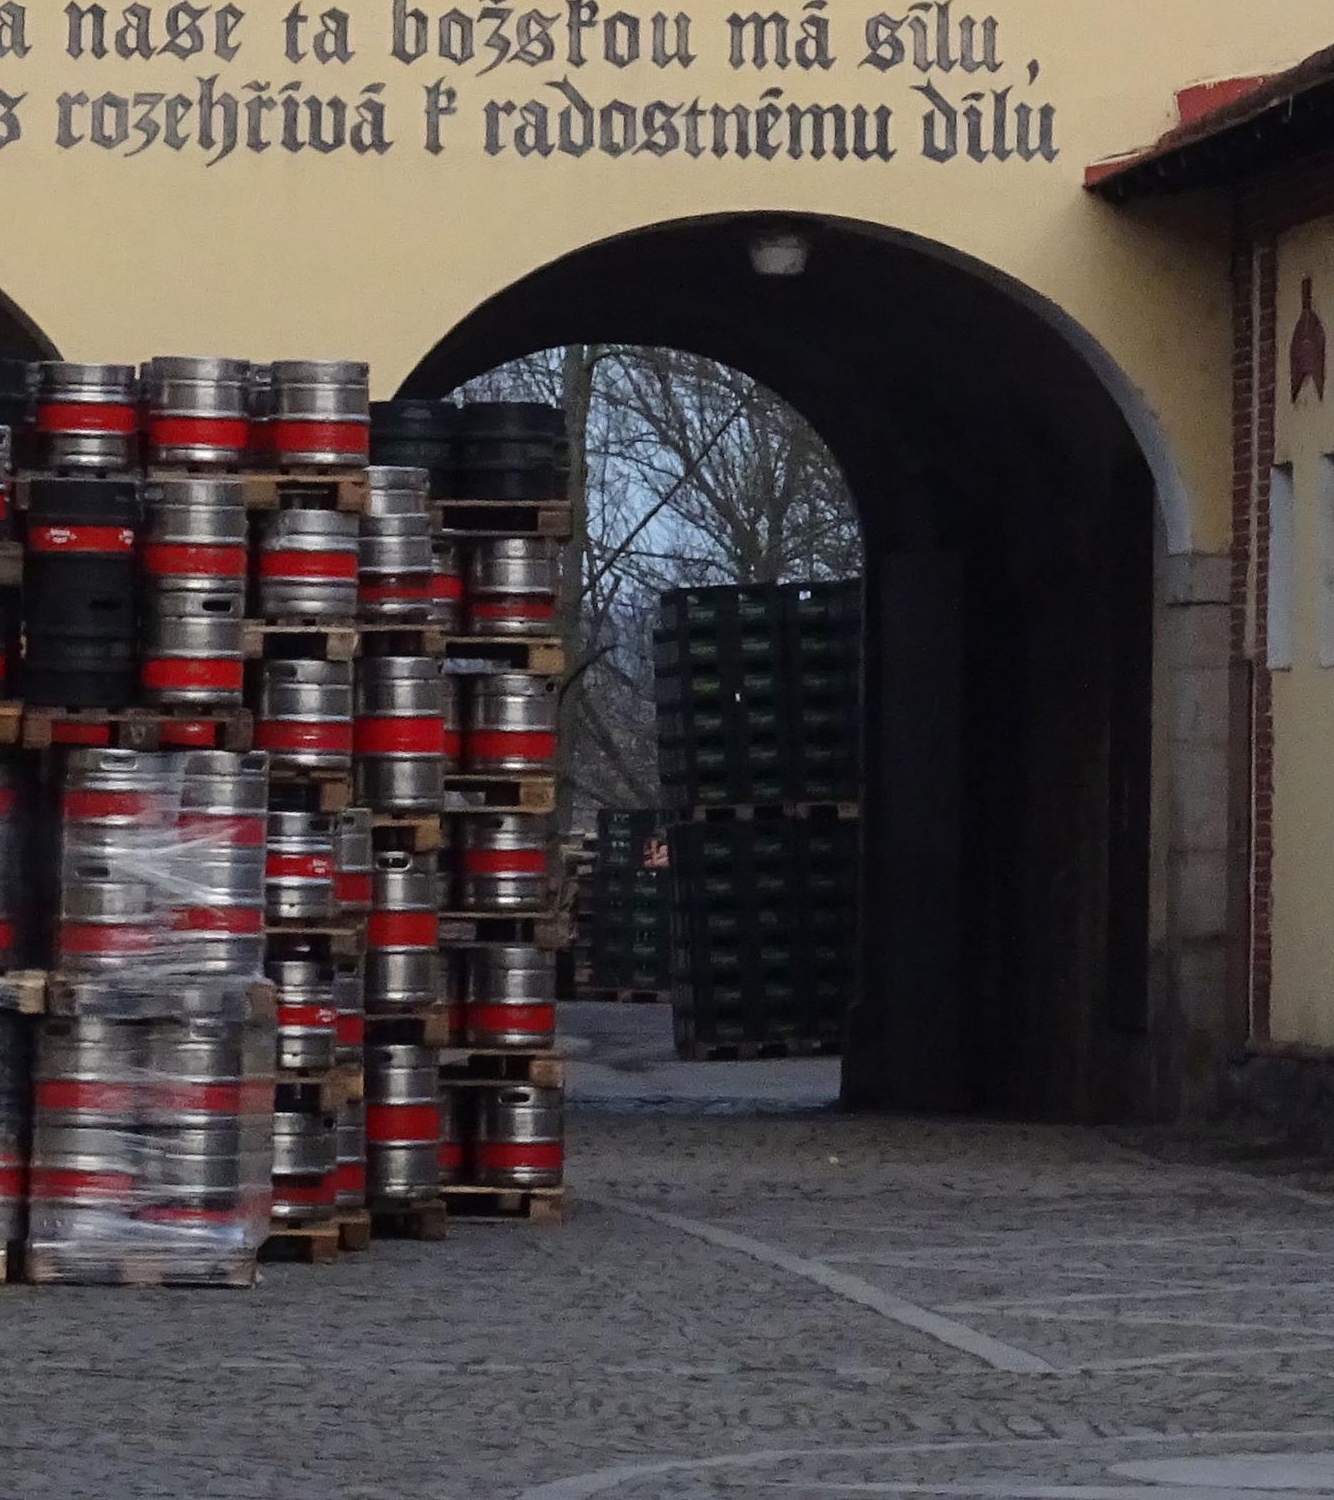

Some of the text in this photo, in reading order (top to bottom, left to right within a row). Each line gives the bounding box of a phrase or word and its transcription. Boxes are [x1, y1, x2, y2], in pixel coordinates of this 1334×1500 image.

[282, 1, 356, 65] ta
[725, 0, 837, 71] má
[55, 73, 394, 168] rozehřívá
[424, 76, 457, 156] k
[483, 74, 898, 163] radostnému
[910, 78, 1060, 164] dílu
